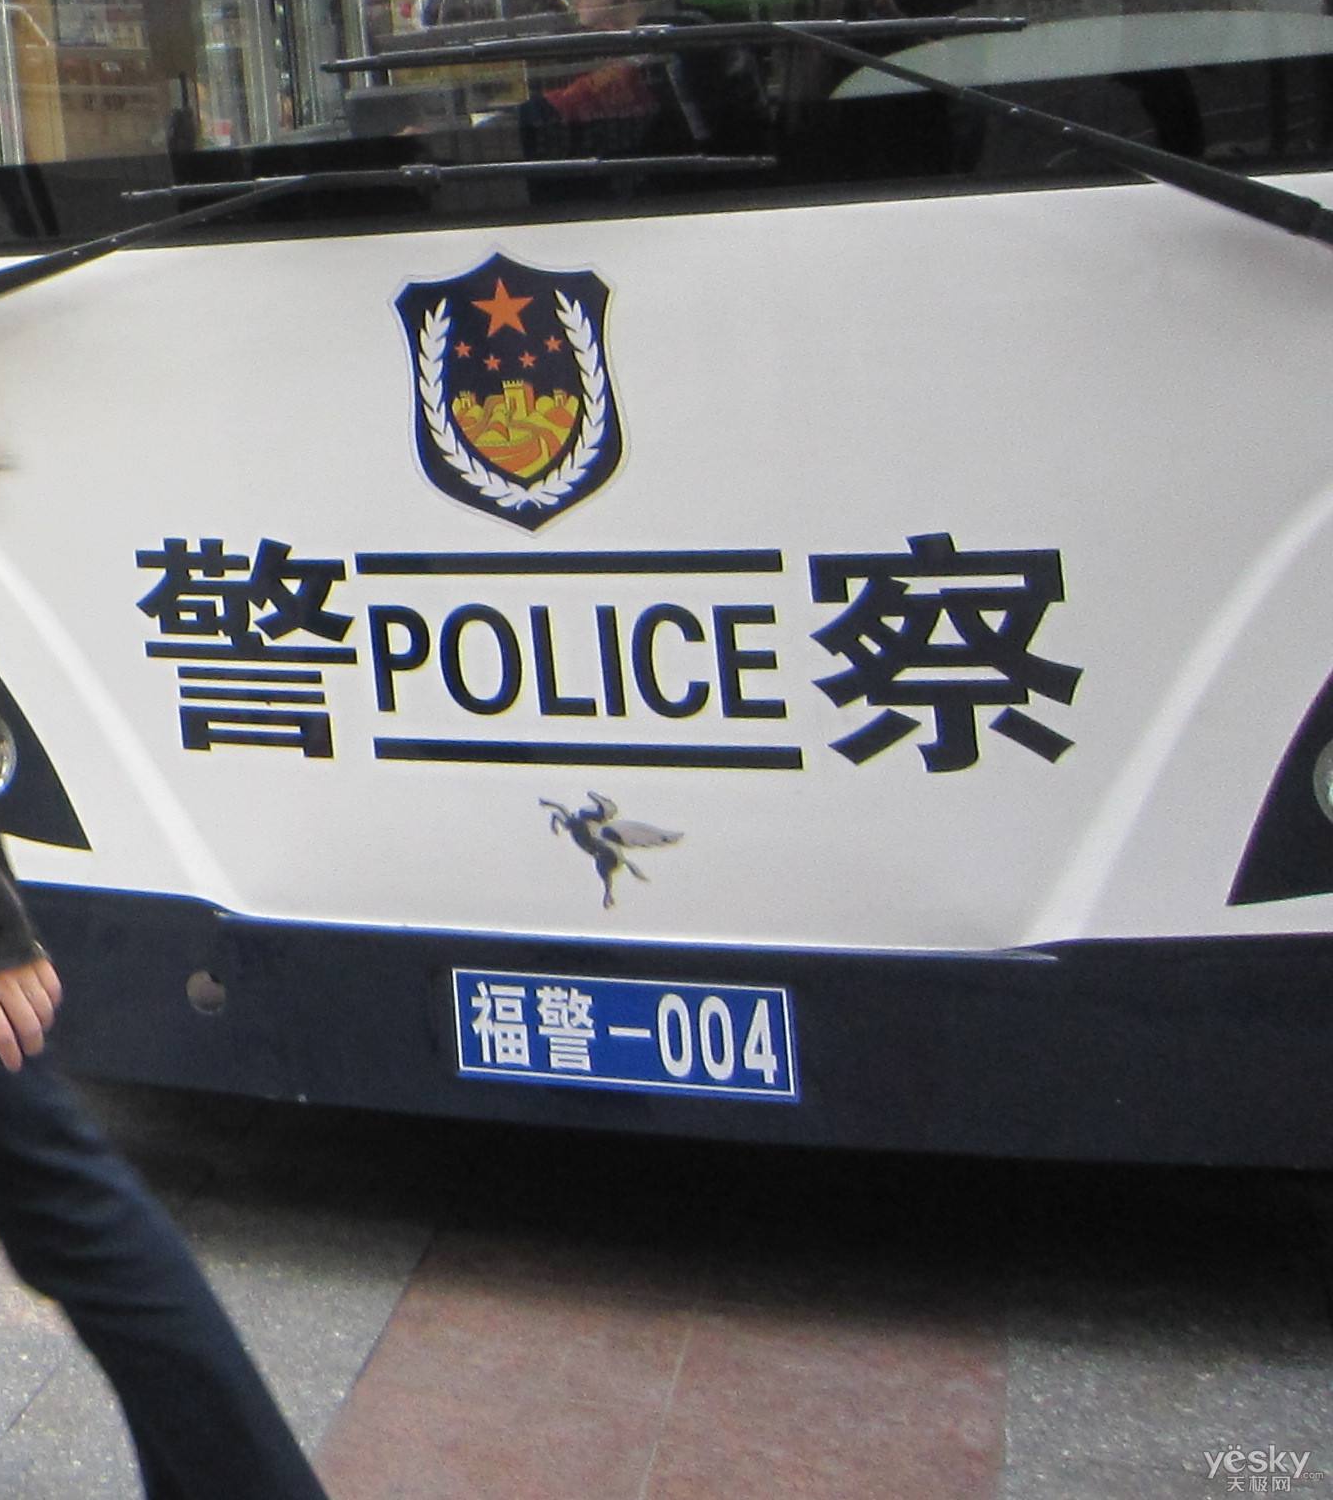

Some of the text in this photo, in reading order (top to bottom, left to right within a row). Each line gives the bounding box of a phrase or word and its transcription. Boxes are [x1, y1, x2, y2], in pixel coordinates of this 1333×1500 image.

[135, 532, 1085, 774] 警 POLICE 察
